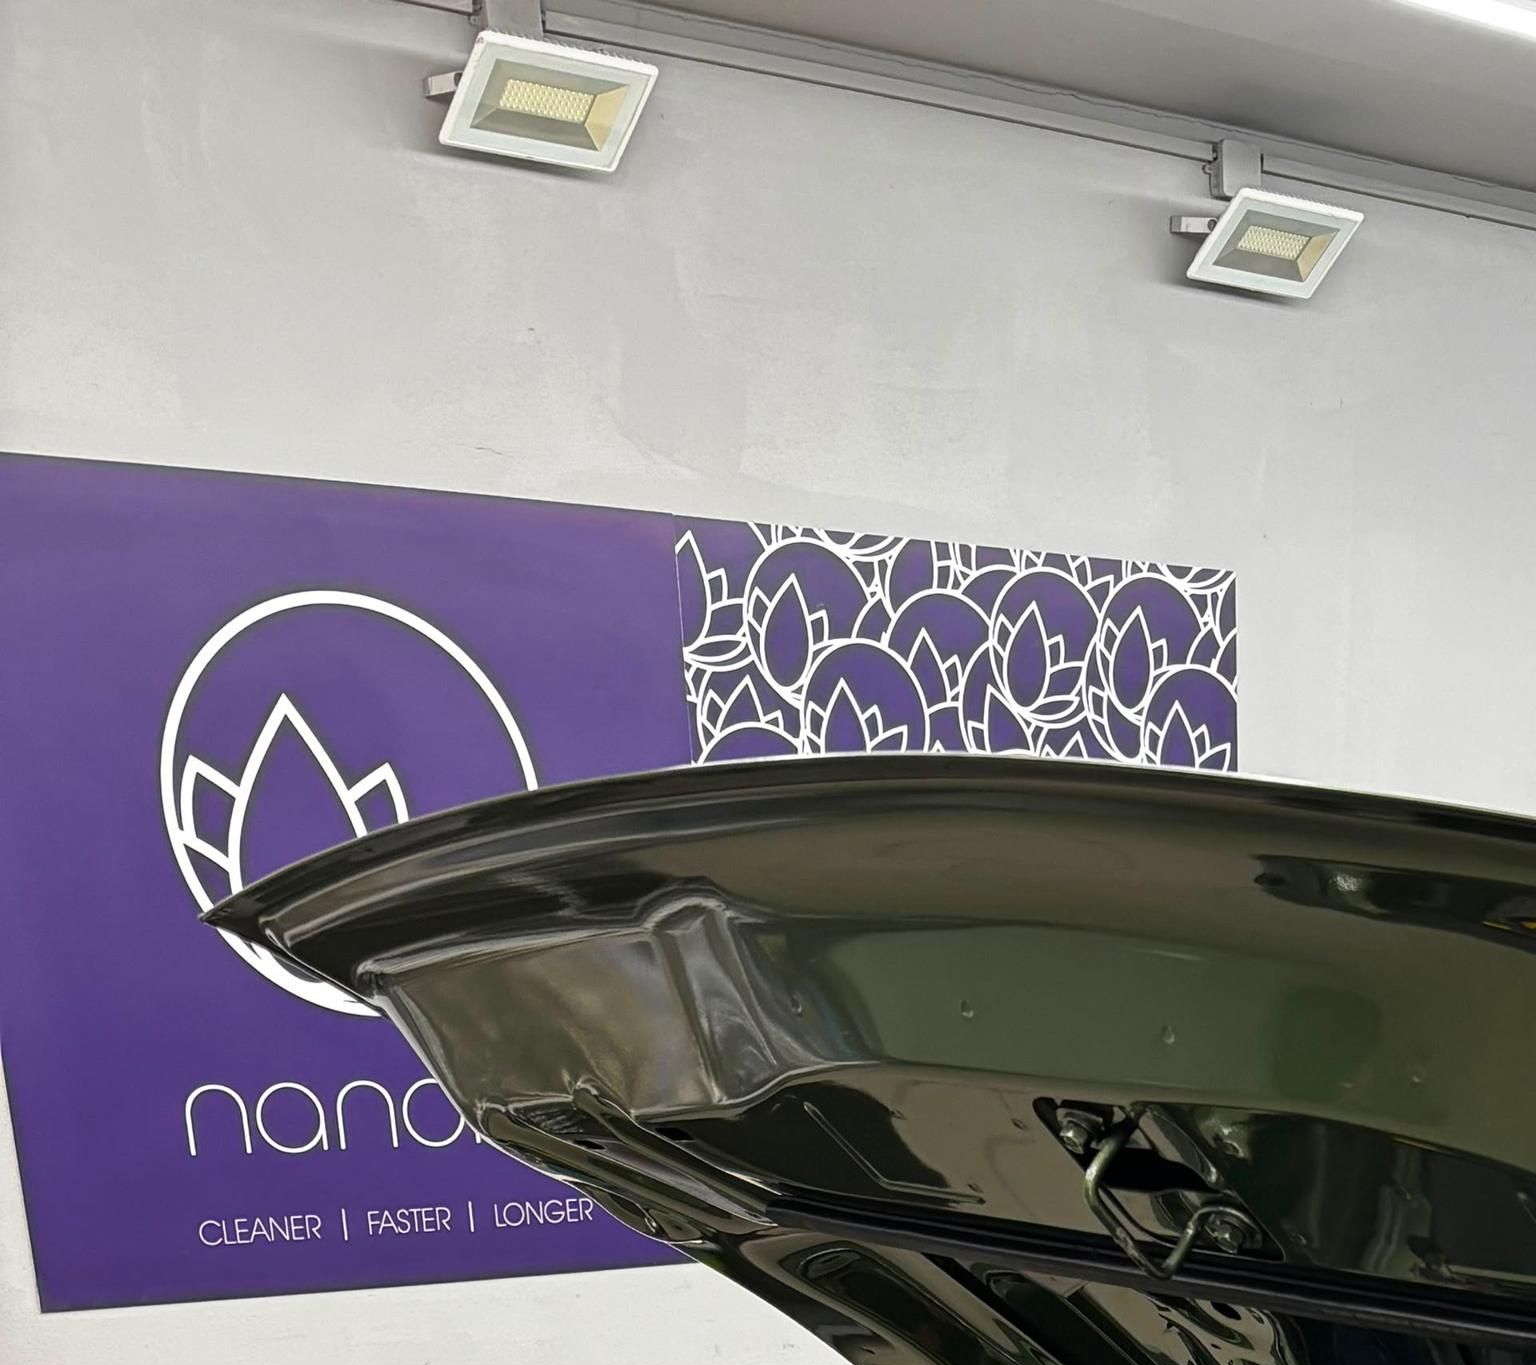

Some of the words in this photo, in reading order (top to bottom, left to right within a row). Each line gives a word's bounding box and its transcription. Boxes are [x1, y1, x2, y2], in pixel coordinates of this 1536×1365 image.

[185, 1078, 482, 1156] nano
[198, 1214, 322, 1246] CLEANER
[366, 1206, 452, 1235] FASTER
[494, 1197, 594, 1228] LONGER
